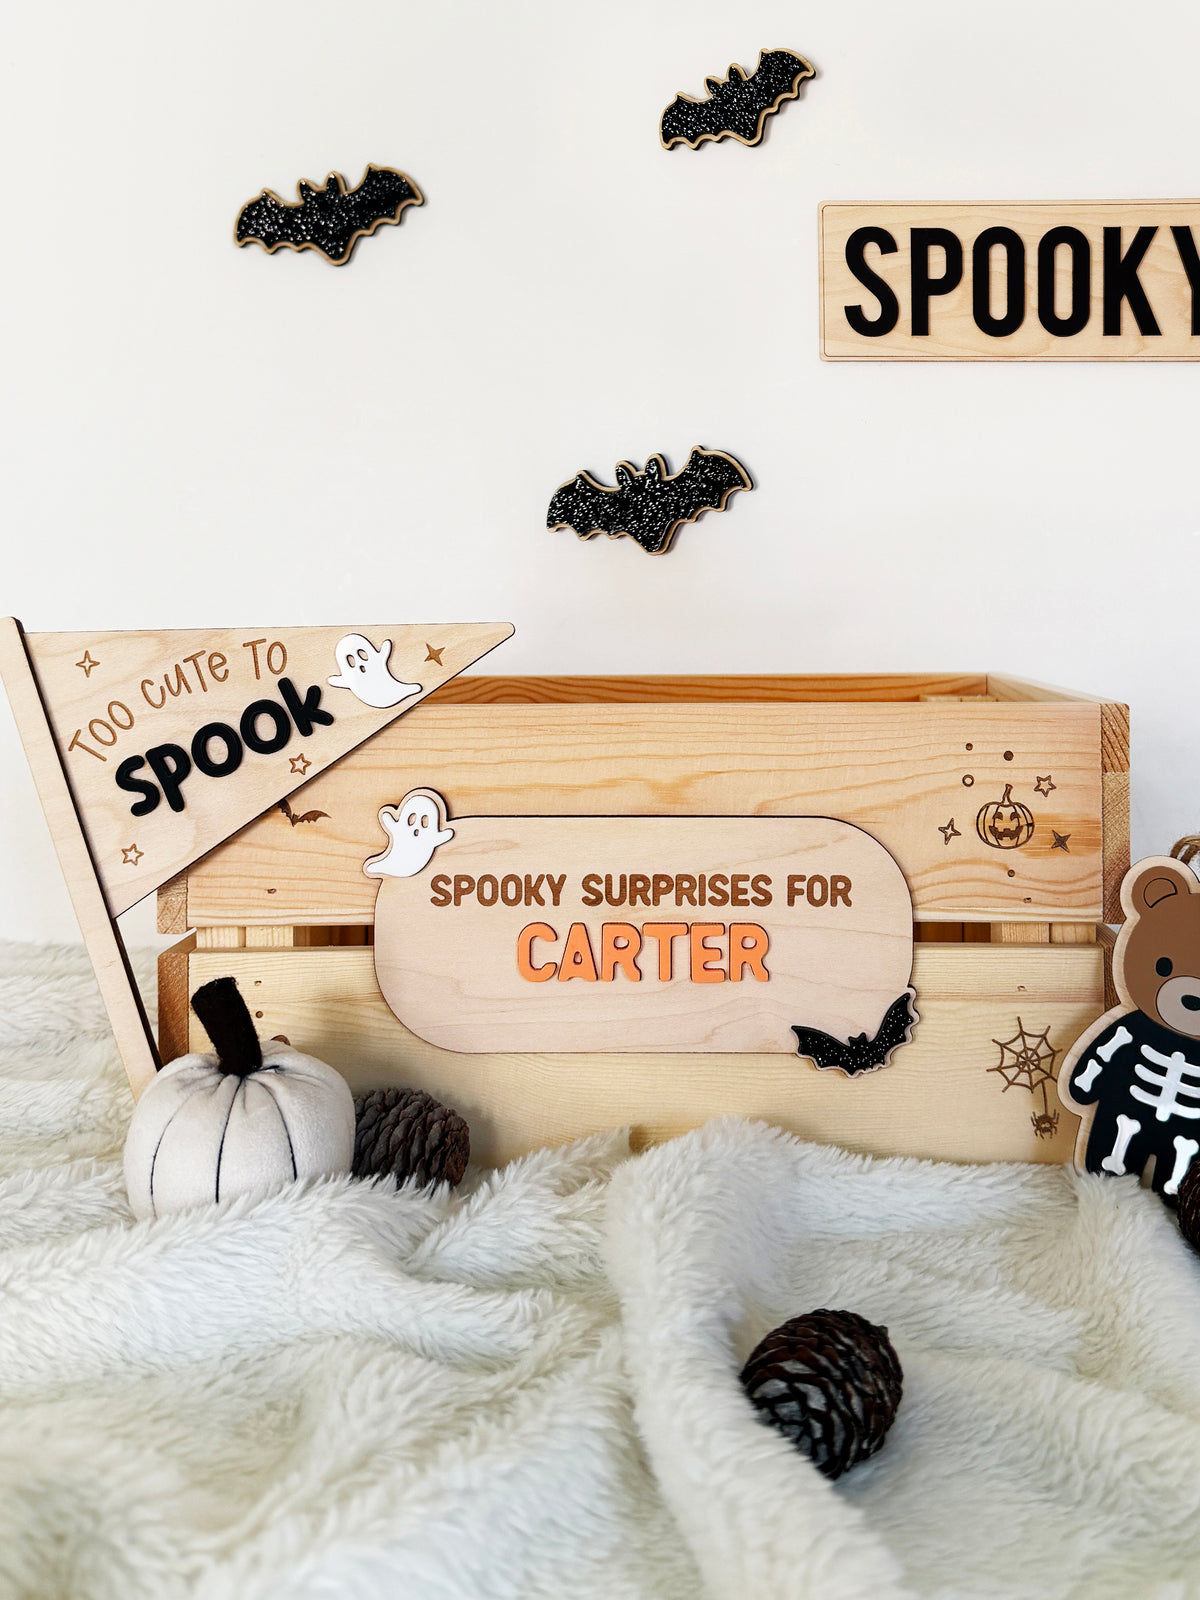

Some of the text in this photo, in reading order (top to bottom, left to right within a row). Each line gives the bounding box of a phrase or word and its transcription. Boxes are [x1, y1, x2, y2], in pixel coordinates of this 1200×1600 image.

[68, 700, 135, 761] TOO
[243, 638, 288, 680] TO
[430, 874, 852, 907] SPOOKY SURPRISES FOR
[517, 922, 770, 983] CARTER
